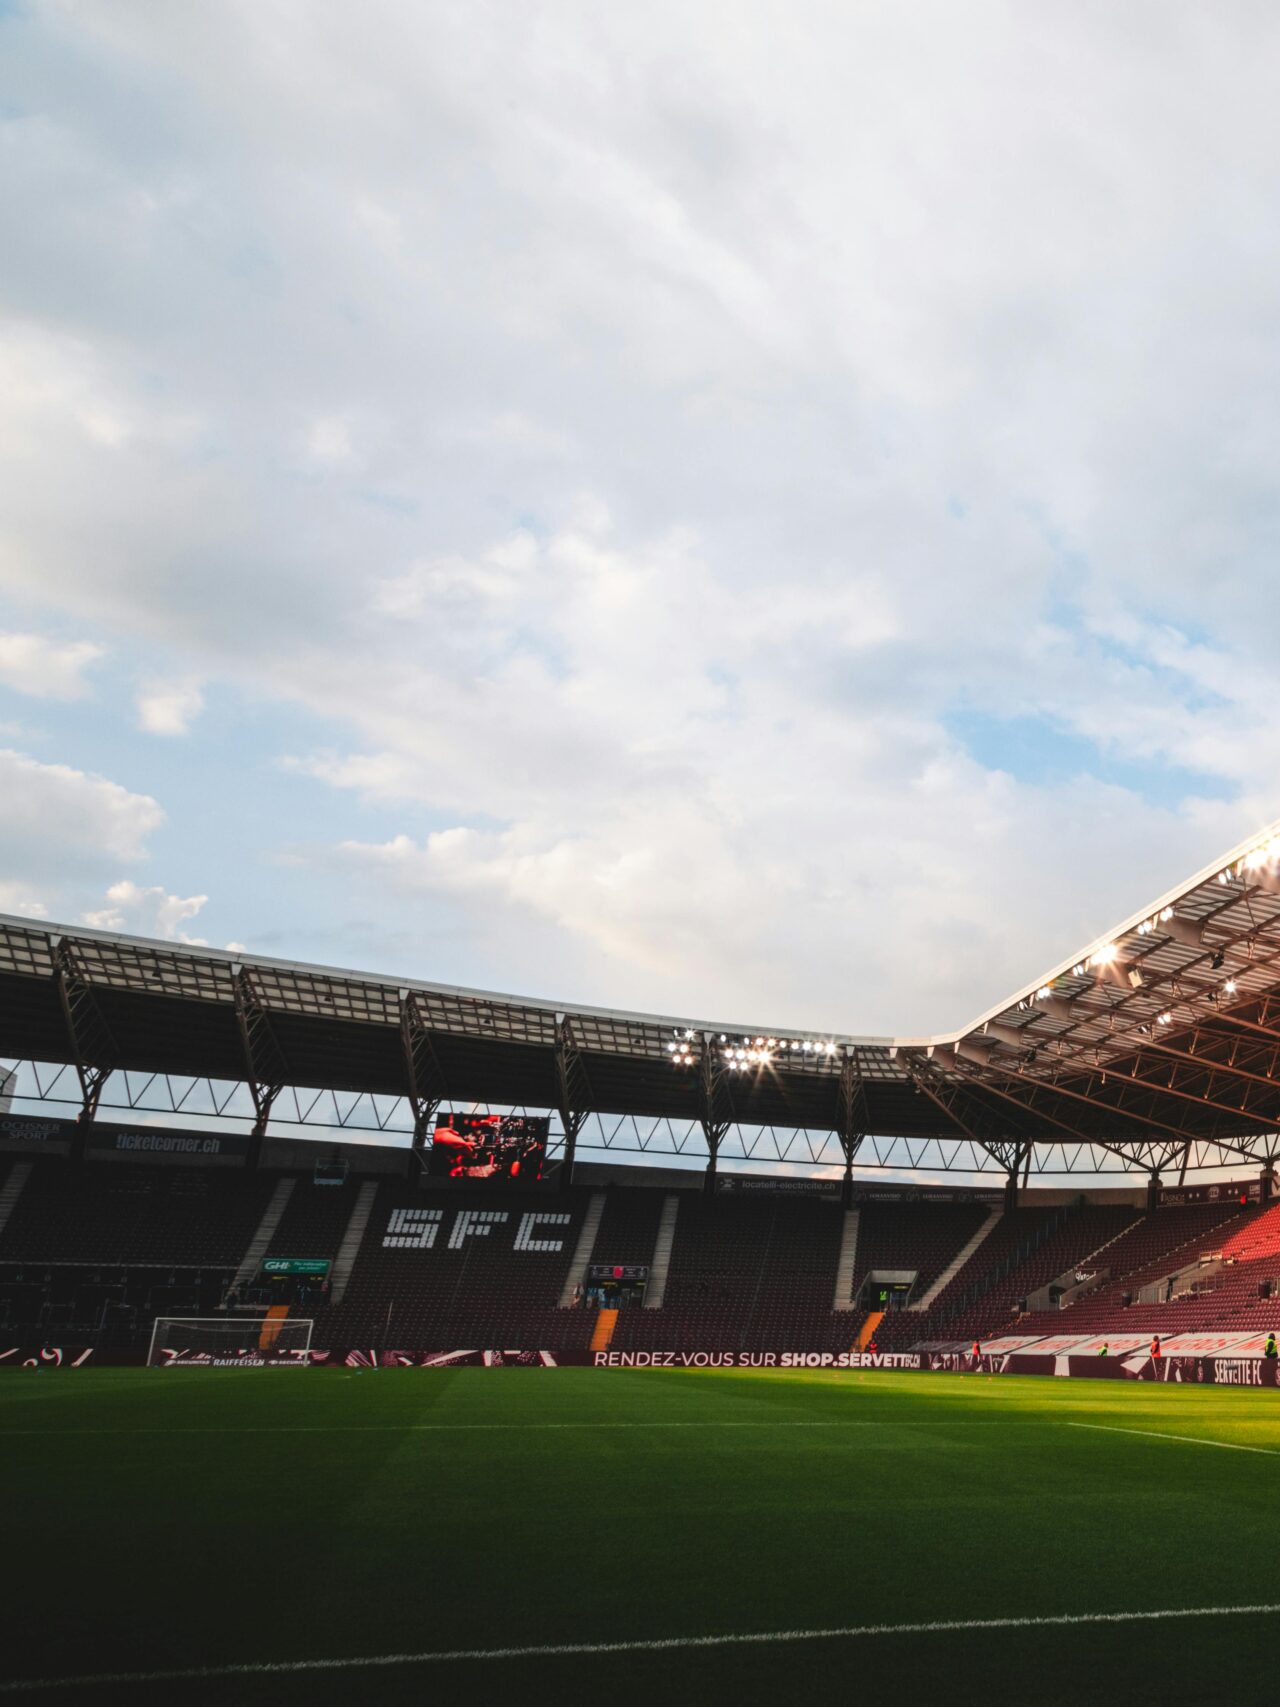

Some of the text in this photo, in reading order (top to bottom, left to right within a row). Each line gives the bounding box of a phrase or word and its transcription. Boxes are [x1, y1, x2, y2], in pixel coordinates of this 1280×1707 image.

[9, 1132, 49, 1141] SPORT
[116, 1133, 220, 1153] ticketcorner.ch
[382, 1208, 571, 1251] SFC
[213, 1358, 265, 1367] RAIFFEISEN
[594, 1351, 756, 1367] RENDEZ-VOUS
[759, 1352, 796, 1367] SUR
[1214, 1359, 1262, 1385] SERVETTE FC
